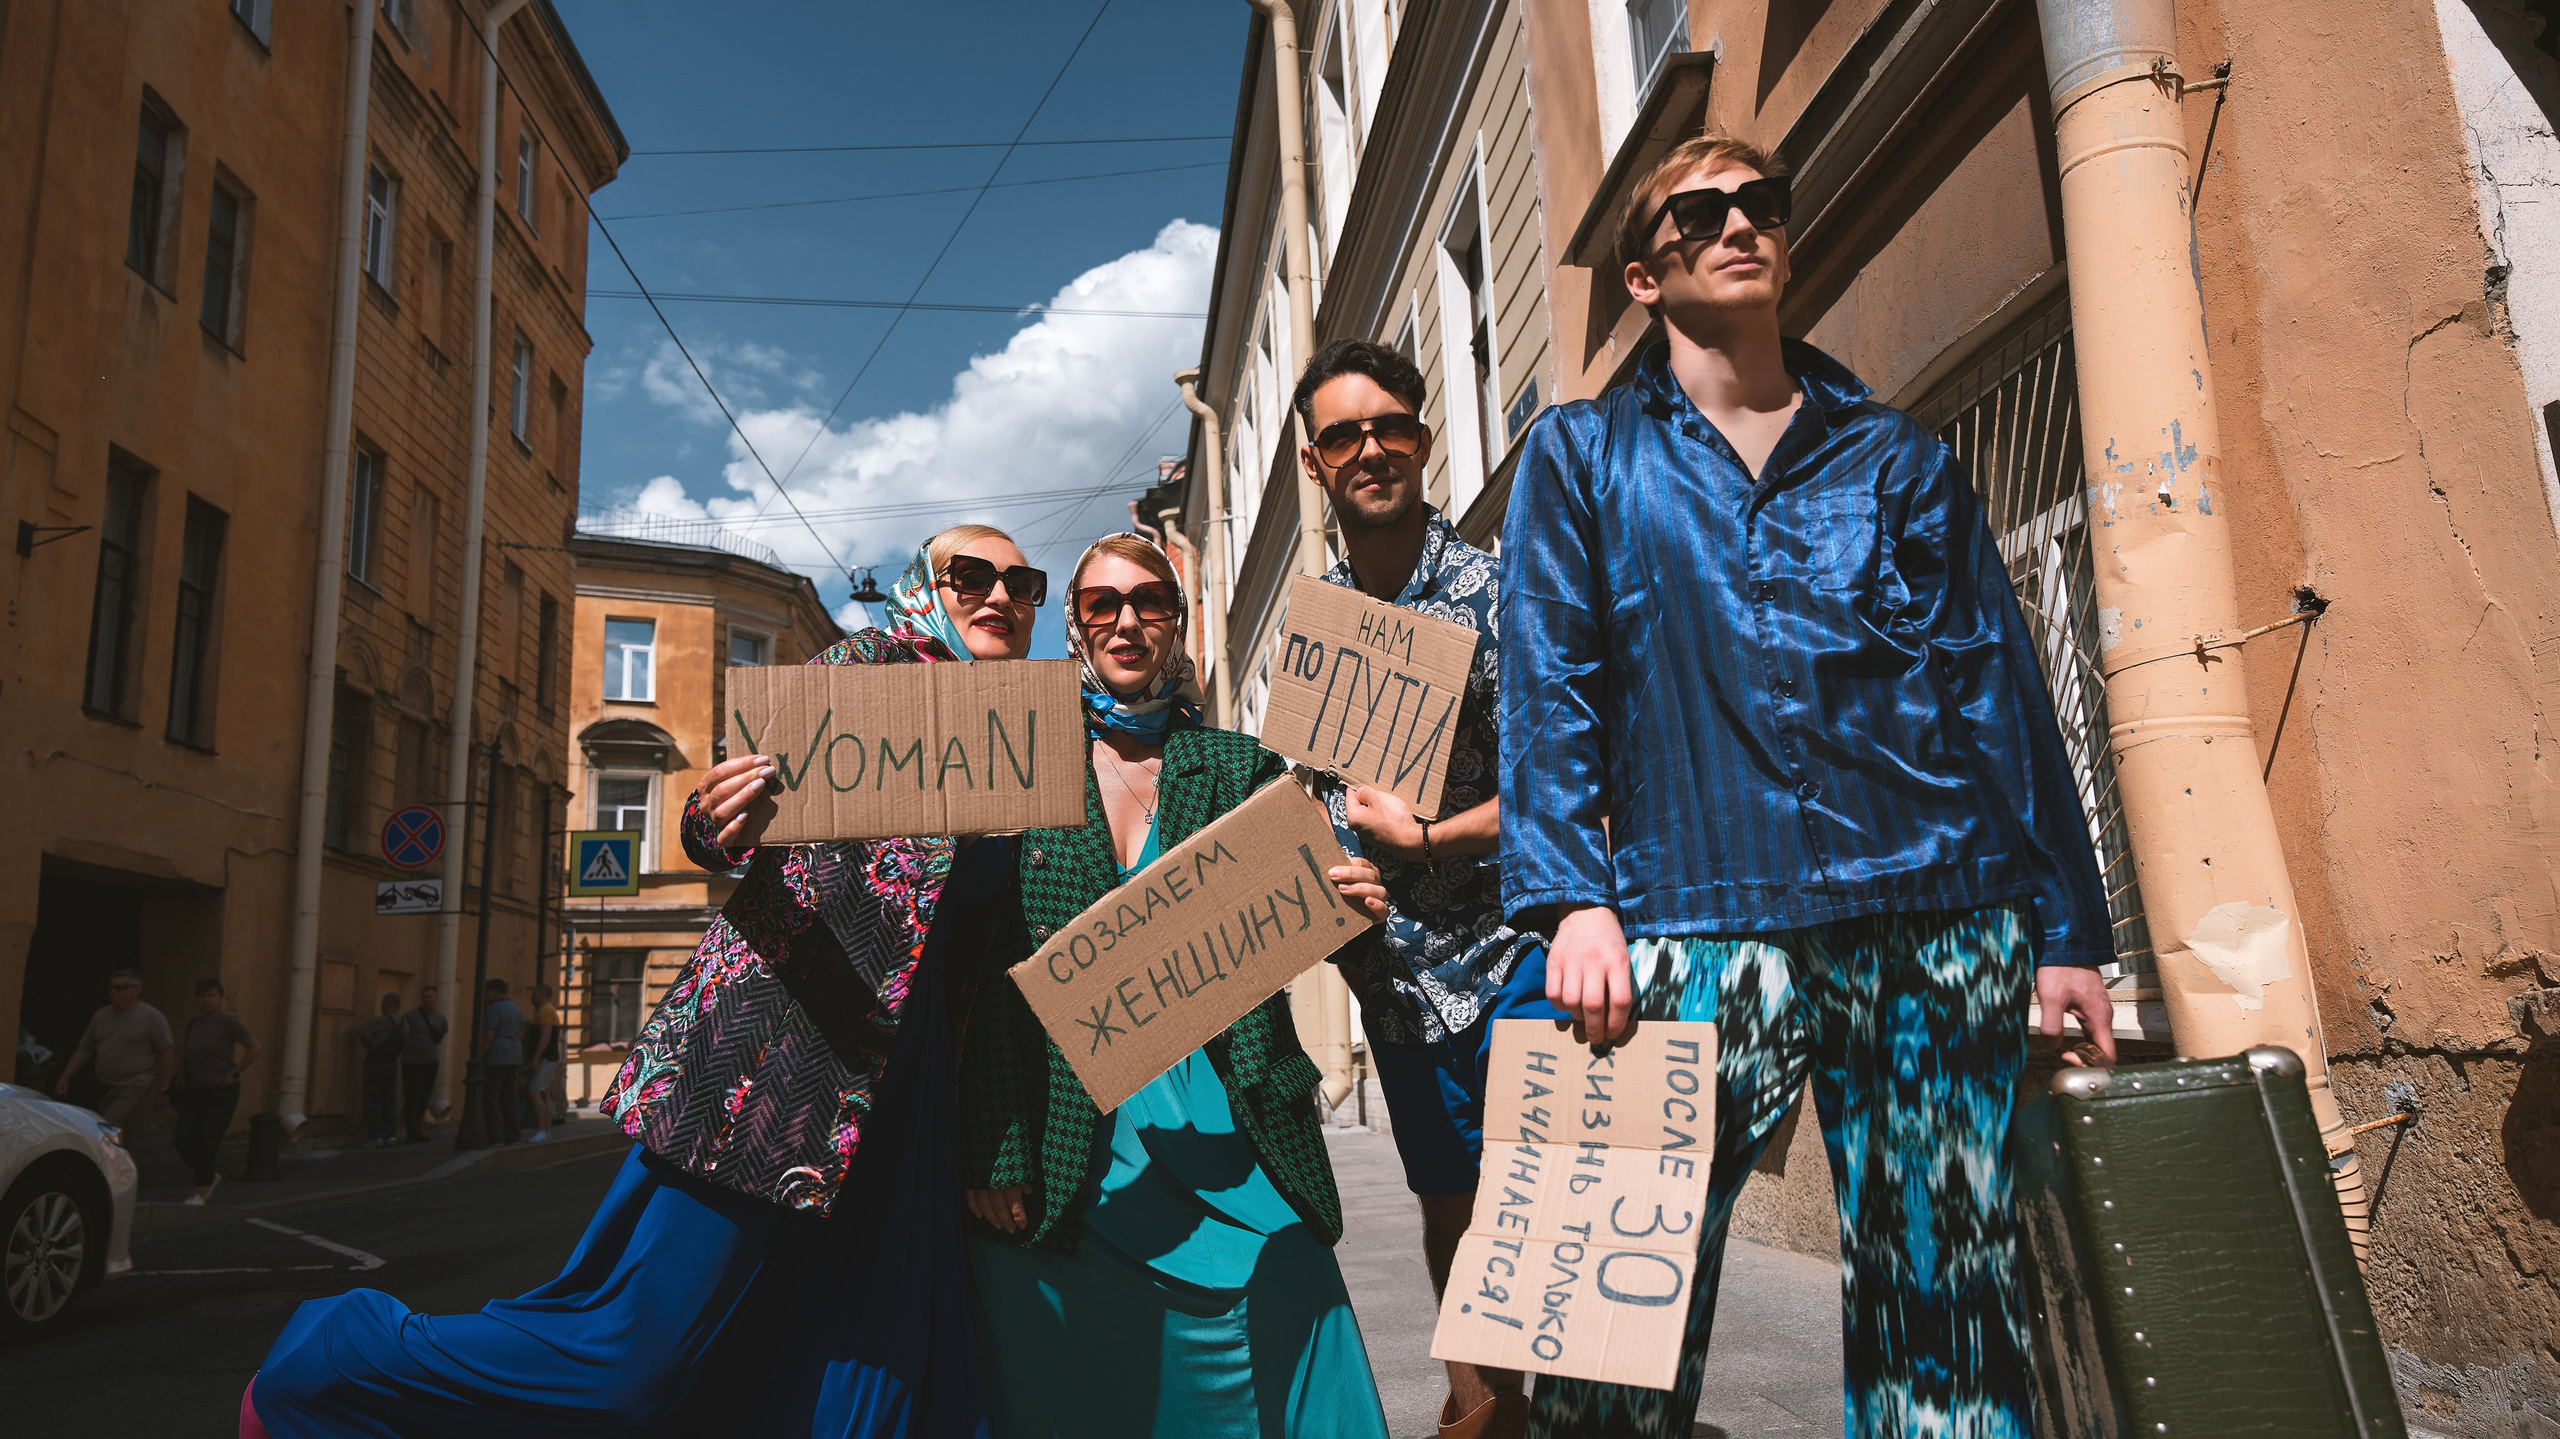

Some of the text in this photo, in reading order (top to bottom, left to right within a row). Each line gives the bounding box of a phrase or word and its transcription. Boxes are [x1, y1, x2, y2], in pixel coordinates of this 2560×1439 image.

[1357, 610, 1415, 666] НАМ
[733, 708, 1037, 792] WOMAN
[1282, 633, 1457, 804] ПО ПУТИ
[1047, 840, 1238, 985] СОЗДАЕМ
[1074, 843, 1346, 1056] ЖЕНЩИНУ!
[1461, 1051, 1558, 1330] НАЧИНАЕТСЯ!
[1597, 1039, 1699, 1306] ПОСЛЕ 30
[1531, 1221, 1591, 1361] ТОЛЬКО
